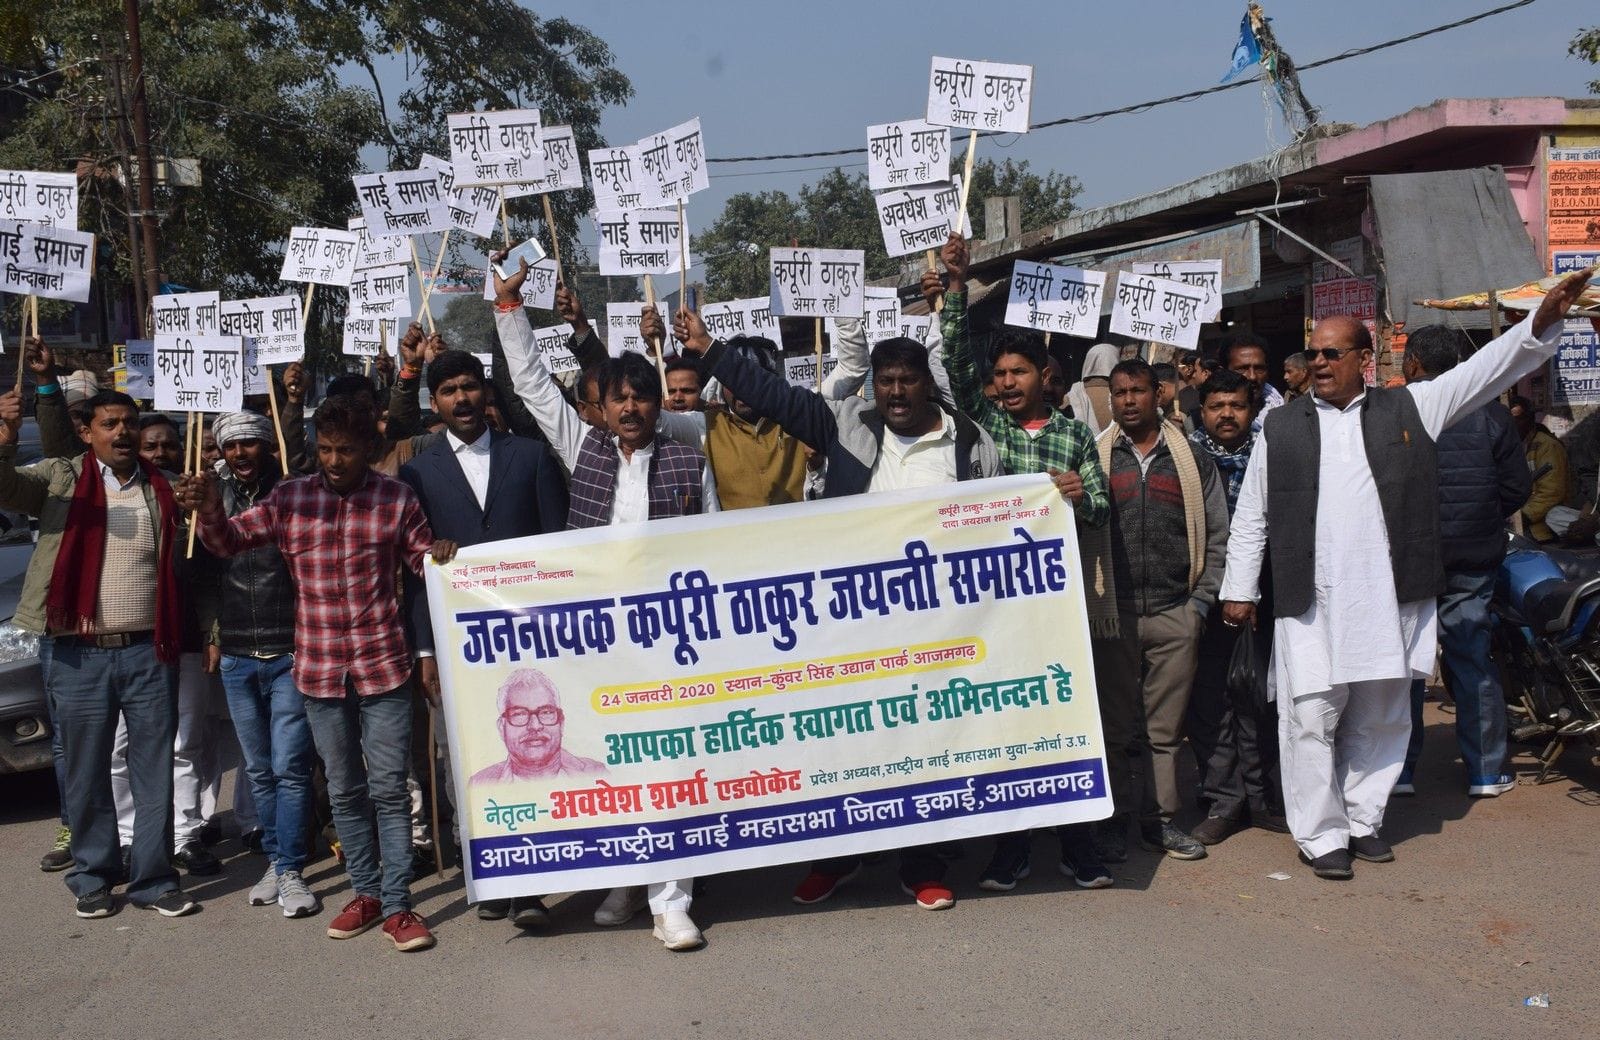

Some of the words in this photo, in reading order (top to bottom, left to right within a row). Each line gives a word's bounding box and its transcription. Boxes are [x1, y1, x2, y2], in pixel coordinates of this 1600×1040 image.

[934, 62, 974, 106] कर्पूरी
[984, 76, 1027, 112] ठाकुर
[951, 109, 977, 125] अमर
[984, 107, 1003, 128] रहें!
[452, 116, 490, 165] कर्पूरी
[499, 124, 537, 160] ठाकुर
[870, 125, 902, 167] कर्पूरी
[911, 130, 947, 163] ठाकुर
[475, 164, 499, 181] अमर
[504, 158, 523, 178] रहें!
[593, 150, 632, 192] कर्पूरी
[642, 135, 670, 182] कर्पूरी
[675, 131, 702, 170] ठाकुर
[887, 169, 908, 184] अमर
[914, 161, 931, 181] रहें!
[36, 184, 74, 219] ठाकुर
[361, 176, 389, 211] नाई
[395, 179, 439, 207] समाज
[617, 194, 640, 208] अमर
[660, 181, 678, 200] अमर
[882, 192, 928, 228] अवधेश
[934, 183, 961, 215] शर्मा
[384, 208, 431, 230] जिन्दाबाद!
[601, 213, 630, 248] नाई
[639, 220, 682, 245] समाज
[34, 236, 89, 270] समाज
[290, 230, 319, 265] कर्पूरी
[323, 240, 356, 270] ठाकुर
[619, 247, 669, 269] जिन्दाबाद!
[6, 263, 65, 292] जिन्दाबाद!
[297, 265, 317, 281] अमर
[351, 273, 369, 301] नाई
[373, 275, 406, 297] समाज
[774, 251, 812, 296] कर्पूरी
[820, 262, 860, 299] ठाकुर
[792, 297, 817, 313] अमर
[823, 294, 840, 314] रहें!
[1015, 263, 1054, 310] कर्पूरी
[1061, 279, 1101, 317] ठाकुर
[1118, 277, 1156, 320] कर्पूरी
[1163, 291, 1201, 328] ठाकुर
[156, 299, 191, 338] अवधेश
[196, 301, 218, 336] शर्मा
[219, 303, 264, 338] अवधेश
[272, 298, 298, 333] शर्मा
[361, 299, 395, 316] जिन्दाबाद!
[703, 304, 745, 335] अवधेश
[877, 301, 898, 329] शर्मा
[1028, 310, 1053, 328] अमर
[1058, 310, 1076, 331] रहें!
[346, 319, 376, 335] अवधश
[1131, 320, 1156, 338] अमर
[1161, 322, 1178, 341] रहें!
[353, 337, 382, 352] जिन्दाबा
[157, 338, 195, 389] कर्पूरी
[203, 350, 240, 390] ठाकुर
[176, 390, 200, 406] अमर
[205, 385, 222, 409] रहें!
[938, 503, 960, 517] कर्पूरी
[1011, 496, 1023, 507] रहें
[942, 520, 959, 529] दादा
[961, 516, 991, 527] जयराज
[994, 509, 1037, 522] शर्मा-अमर
[1039, 505, 1050, 517] रहें
[471, 559, 537, 576] समाज-जिन्दाबाद
[482, 576, 498, 588] नाई
[499, 569, 575, 585] महासभा-जिन्दाबाद
[456, 598, 615, 664] जननायक
[621, 569, 722, 667] कर्पूरी
[723, 572, 819, 651] ठाकुर
[821, 539, 941, 621] जयन्ती
[943, 526, 1066, 604] समारोह
[601, 694, 621, 708] 24
[626, 684, 673, 705] जनवरी
[678, 683, 715, 698] 2020
[807, 662, 836, 684] सिंह
[839, 659, 875, 678] उद्यान
[879, 650, 910, 671] पार्क
[913, 644, 977, 667] आजमगढ़
[605, 725, 695, 766] आपका
[702, 707, 786, 754] हार्दिक
[787, 699, 874, 742] स्वागत
[876, 682, 919, 724] एवं
[1046, 662, 1073, 702] है
[550, 780, 643, 820] अवधेश
[647, 768, 709, 818] शर्मा
[714, 767, 802, 802] एडवोकेट
[809, 772, 838, 787] प्रदेश
[928, 749, 950, 769] नाई
[953, 745, 1001, 764] महासभा
[1005, 736, 1062, 761] युवा-मोर्चा
[1065, 733, 1090, 749] उ.प्र.
[480, 826, 676, 868] आयोजक-राष्ट्रीय
[685, 814, 730, 847] नाई
[739, 807, 836, 838] महासभा
[842, 796, 904, 827] जिला
